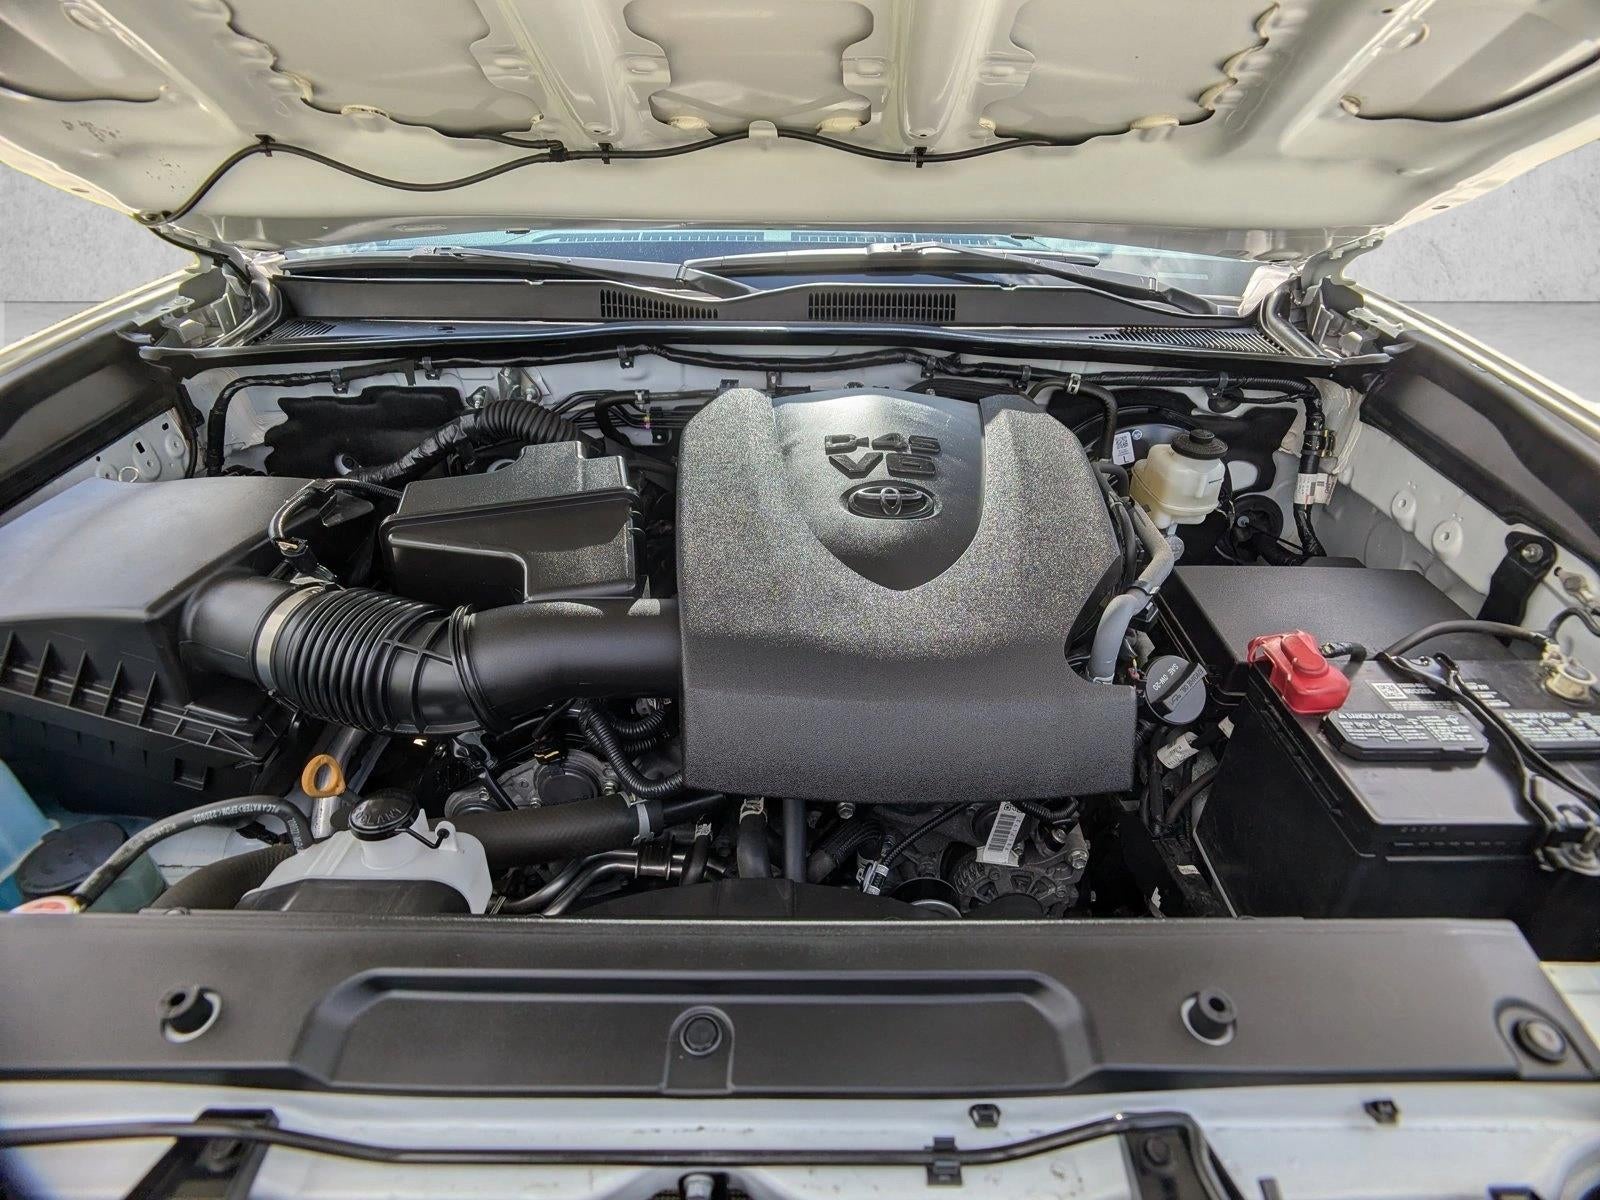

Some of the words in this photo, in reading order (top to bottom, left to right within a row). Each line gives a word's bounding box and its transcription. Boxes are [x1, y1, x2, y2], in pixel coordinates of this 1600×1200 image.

[825, 433, 941, 455] D-4S
[829, 452, 937, 480] V6
[1167, 663, 1179, 676] SAE
[1152, 674, 1169, 691] 0W-20
